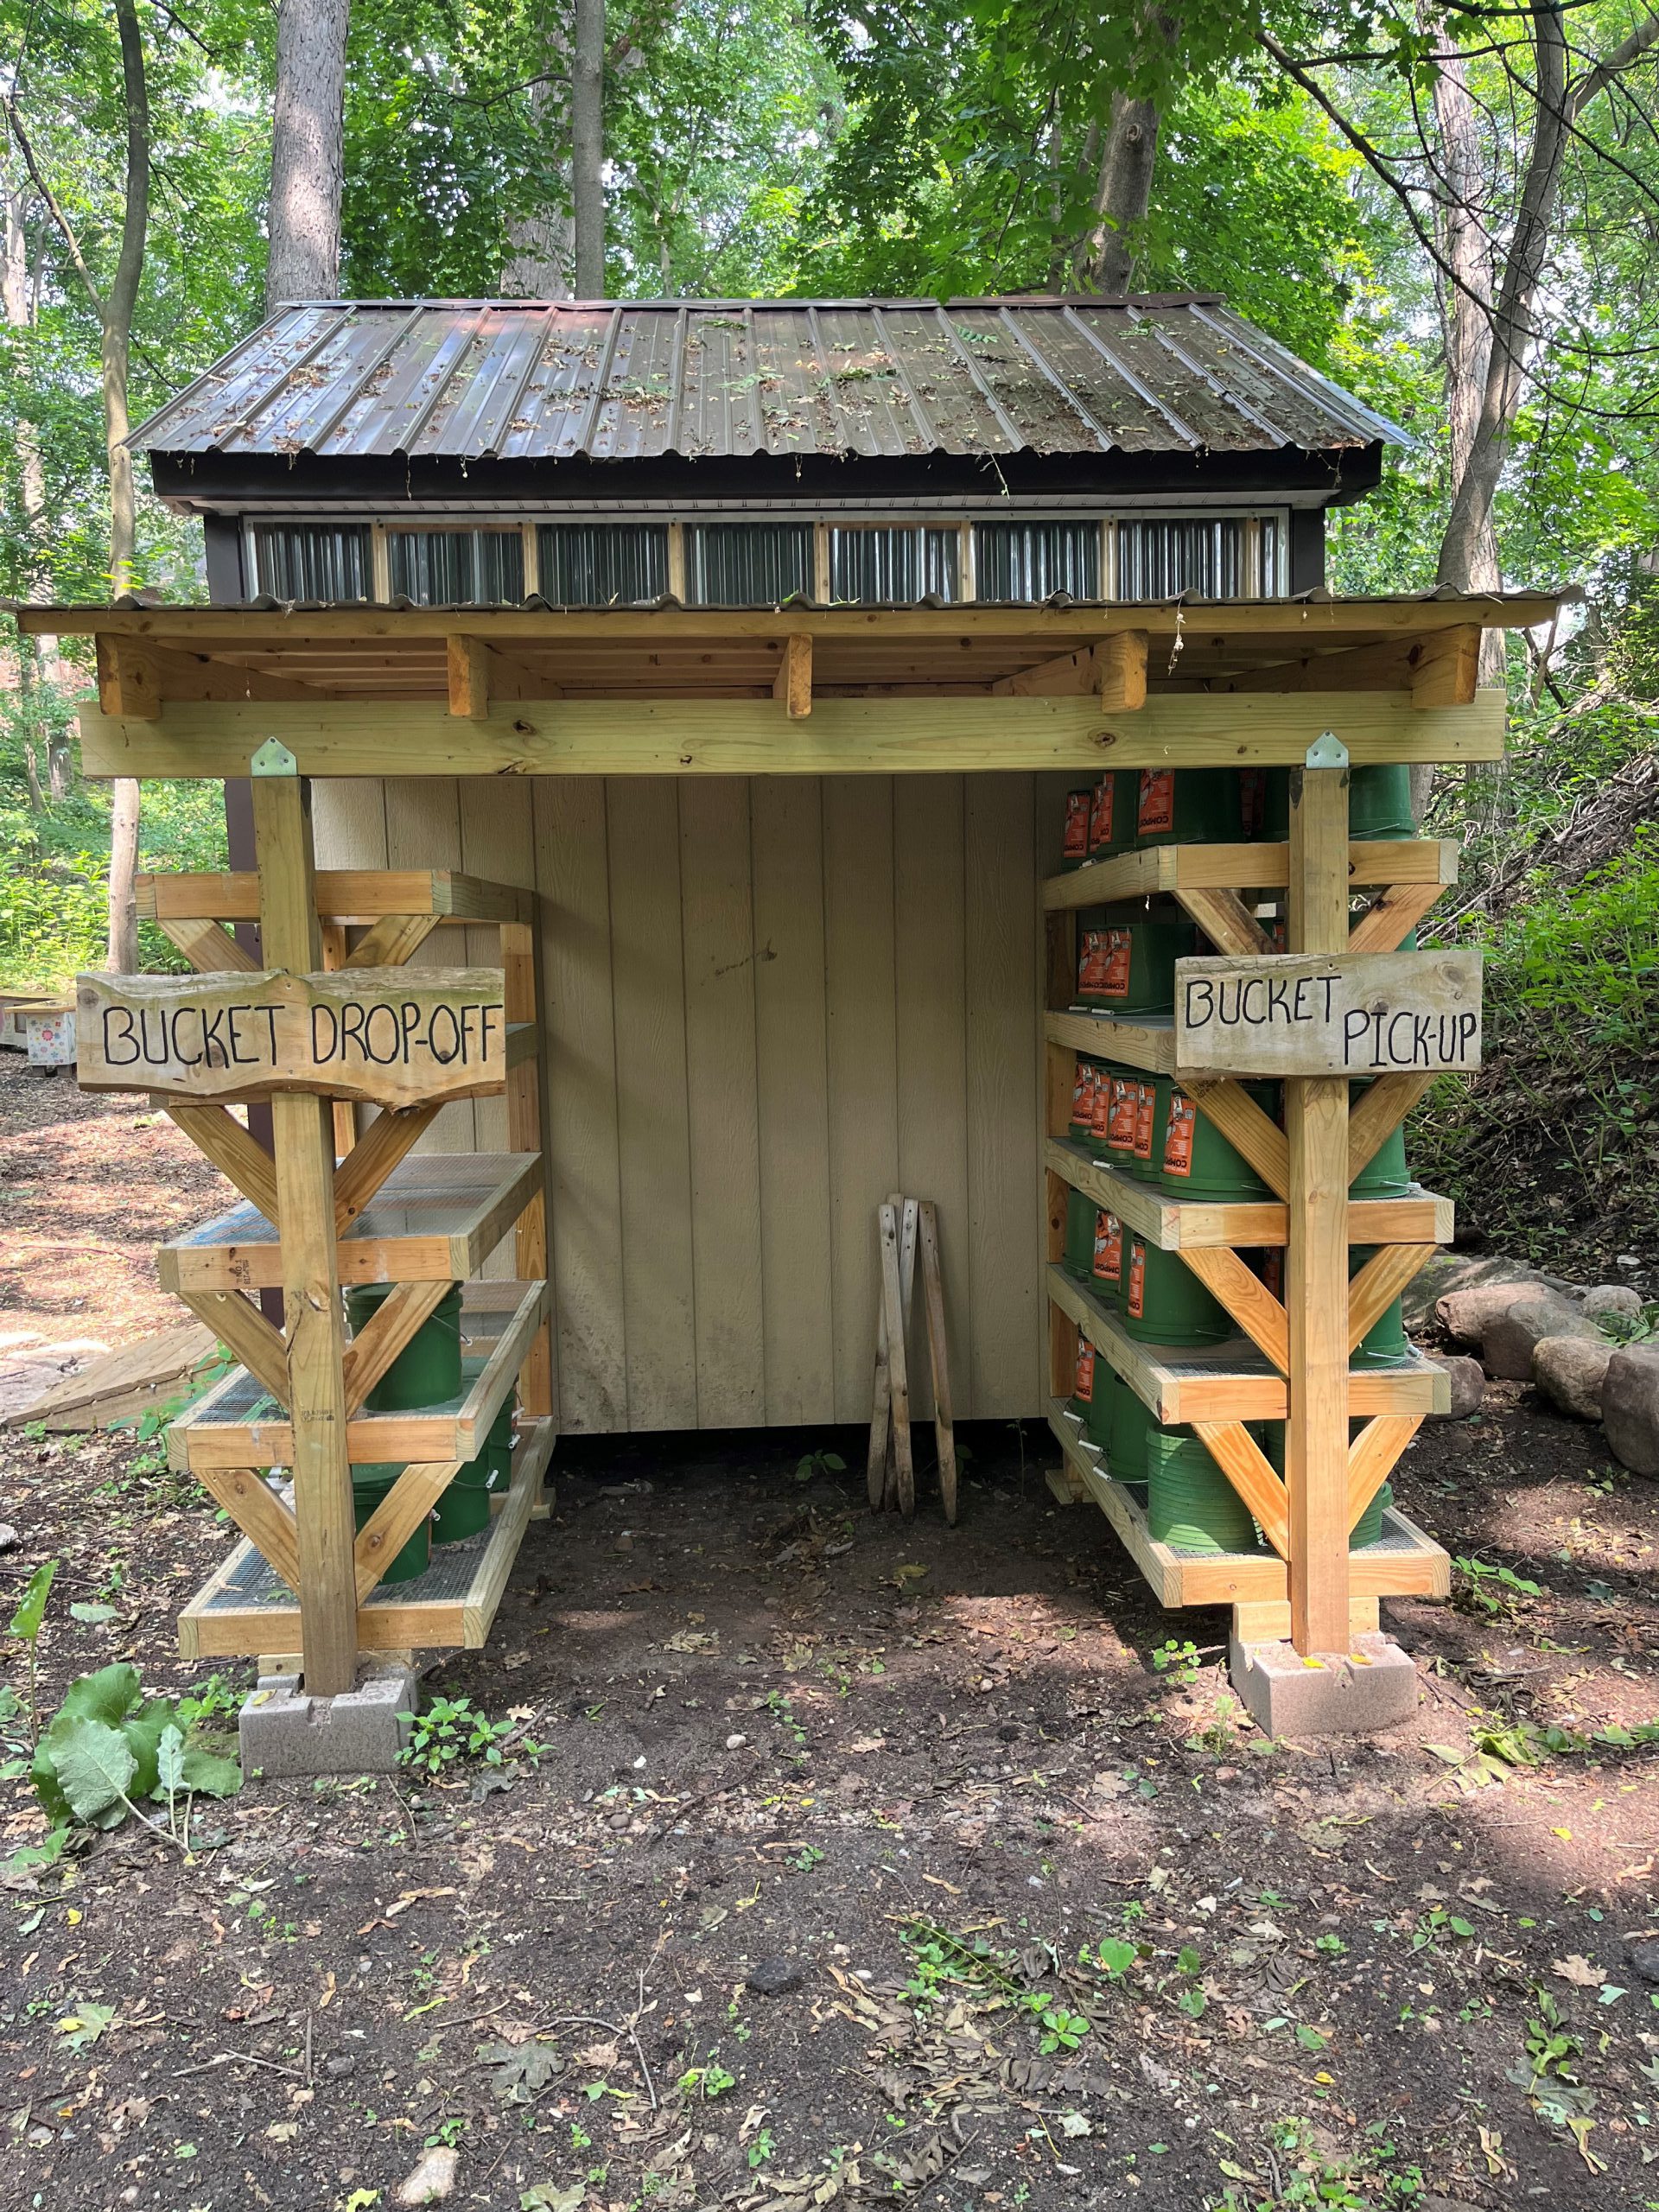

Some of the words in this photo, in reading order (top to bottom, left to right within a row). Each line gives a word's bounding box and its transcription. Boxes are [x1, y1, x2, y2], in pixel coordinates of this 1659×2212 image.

[1185, 975, 1342, 1029] BUCKET
[102, 1005, 285, 1069] BUCKET
[311, 1003, 505, 1065] DROP-OFF
[1344, 1009, 1478, 1067] PICK-UP
